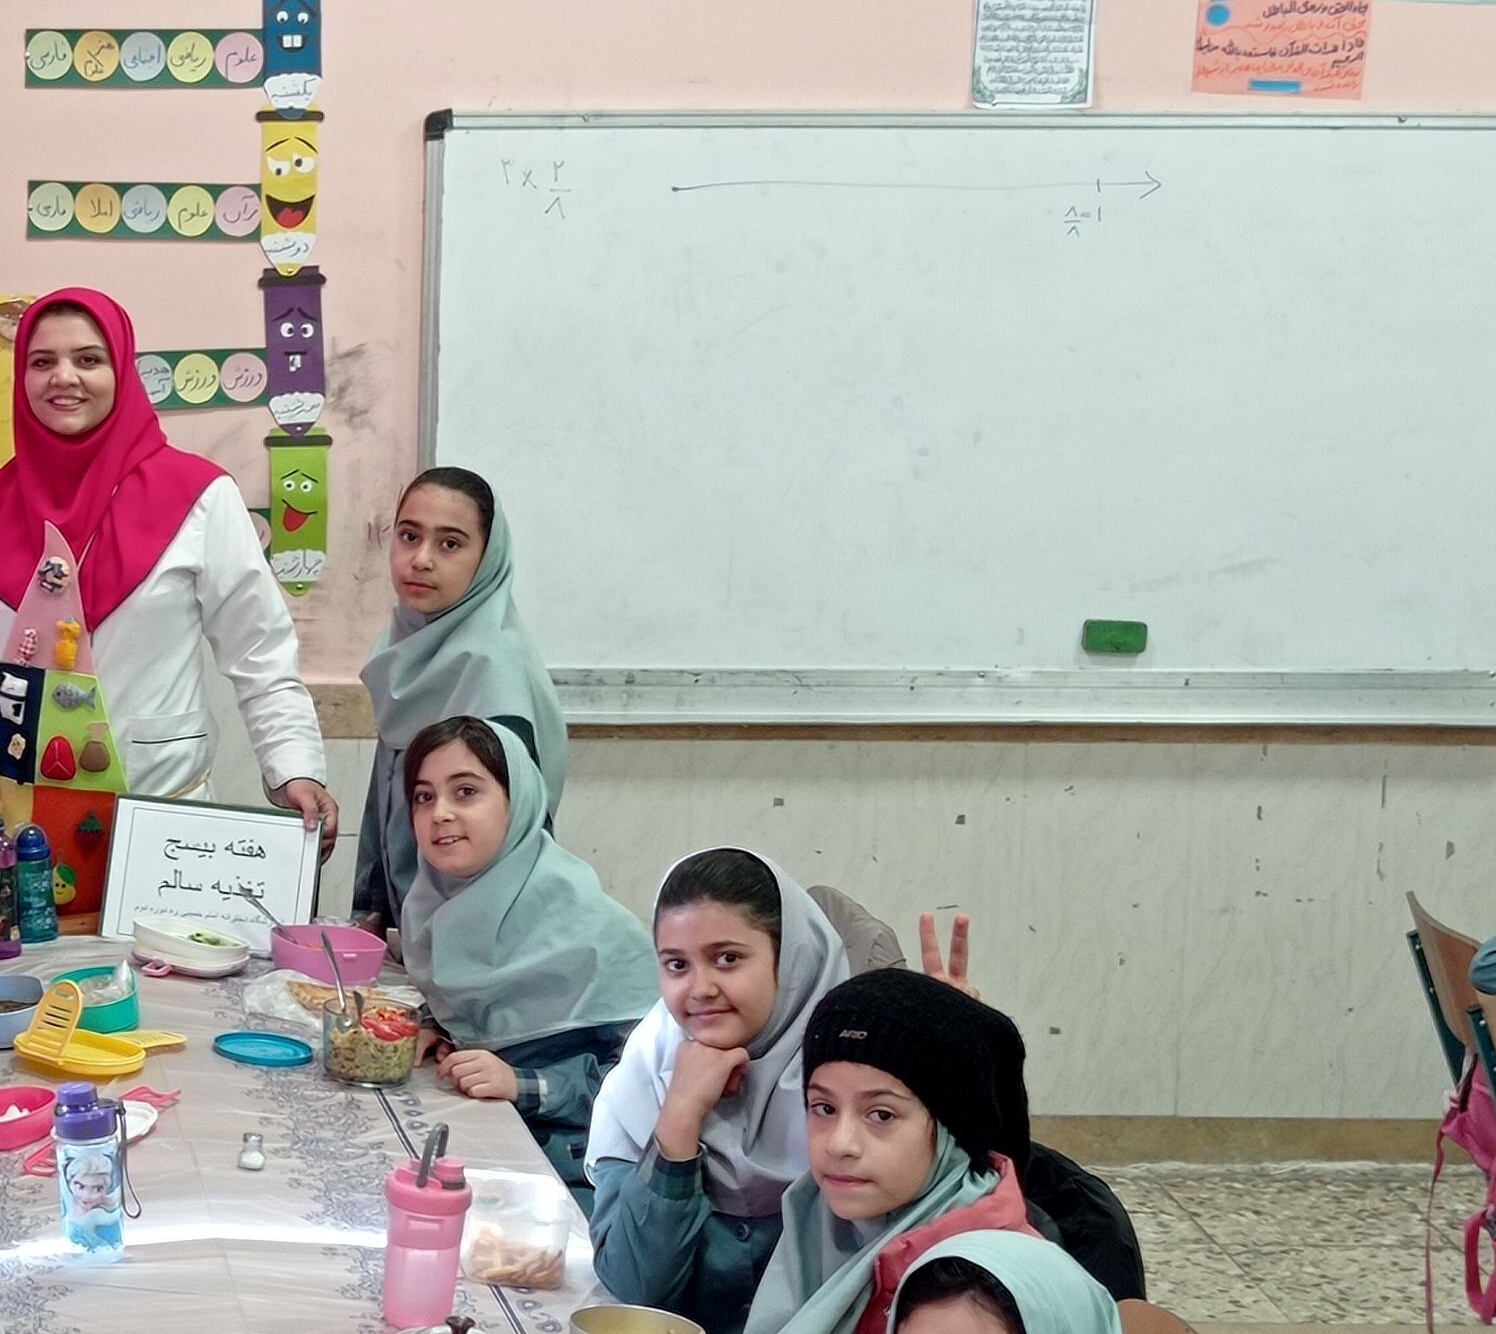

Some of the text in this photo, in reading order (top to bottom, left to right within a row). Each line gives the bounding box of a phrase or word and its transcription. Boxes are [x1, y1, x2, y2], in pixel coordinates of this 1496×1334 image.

[30, 39, 67, 71] فارسی
[169, 41, 208, 72] ریاضی
[224, 45, 258, 82] علوم
[89, 198, 113, 218] املا
[177, 197, 208, 230] علوم
[222, 194, 258, 224] قرآن
[176, 368, 217, 393] ورزش
[222, 367, 263, 391] ورزش
[223, 837, 267, 860] هفته
[156, 868, 266, 902] تغذیه سالم
